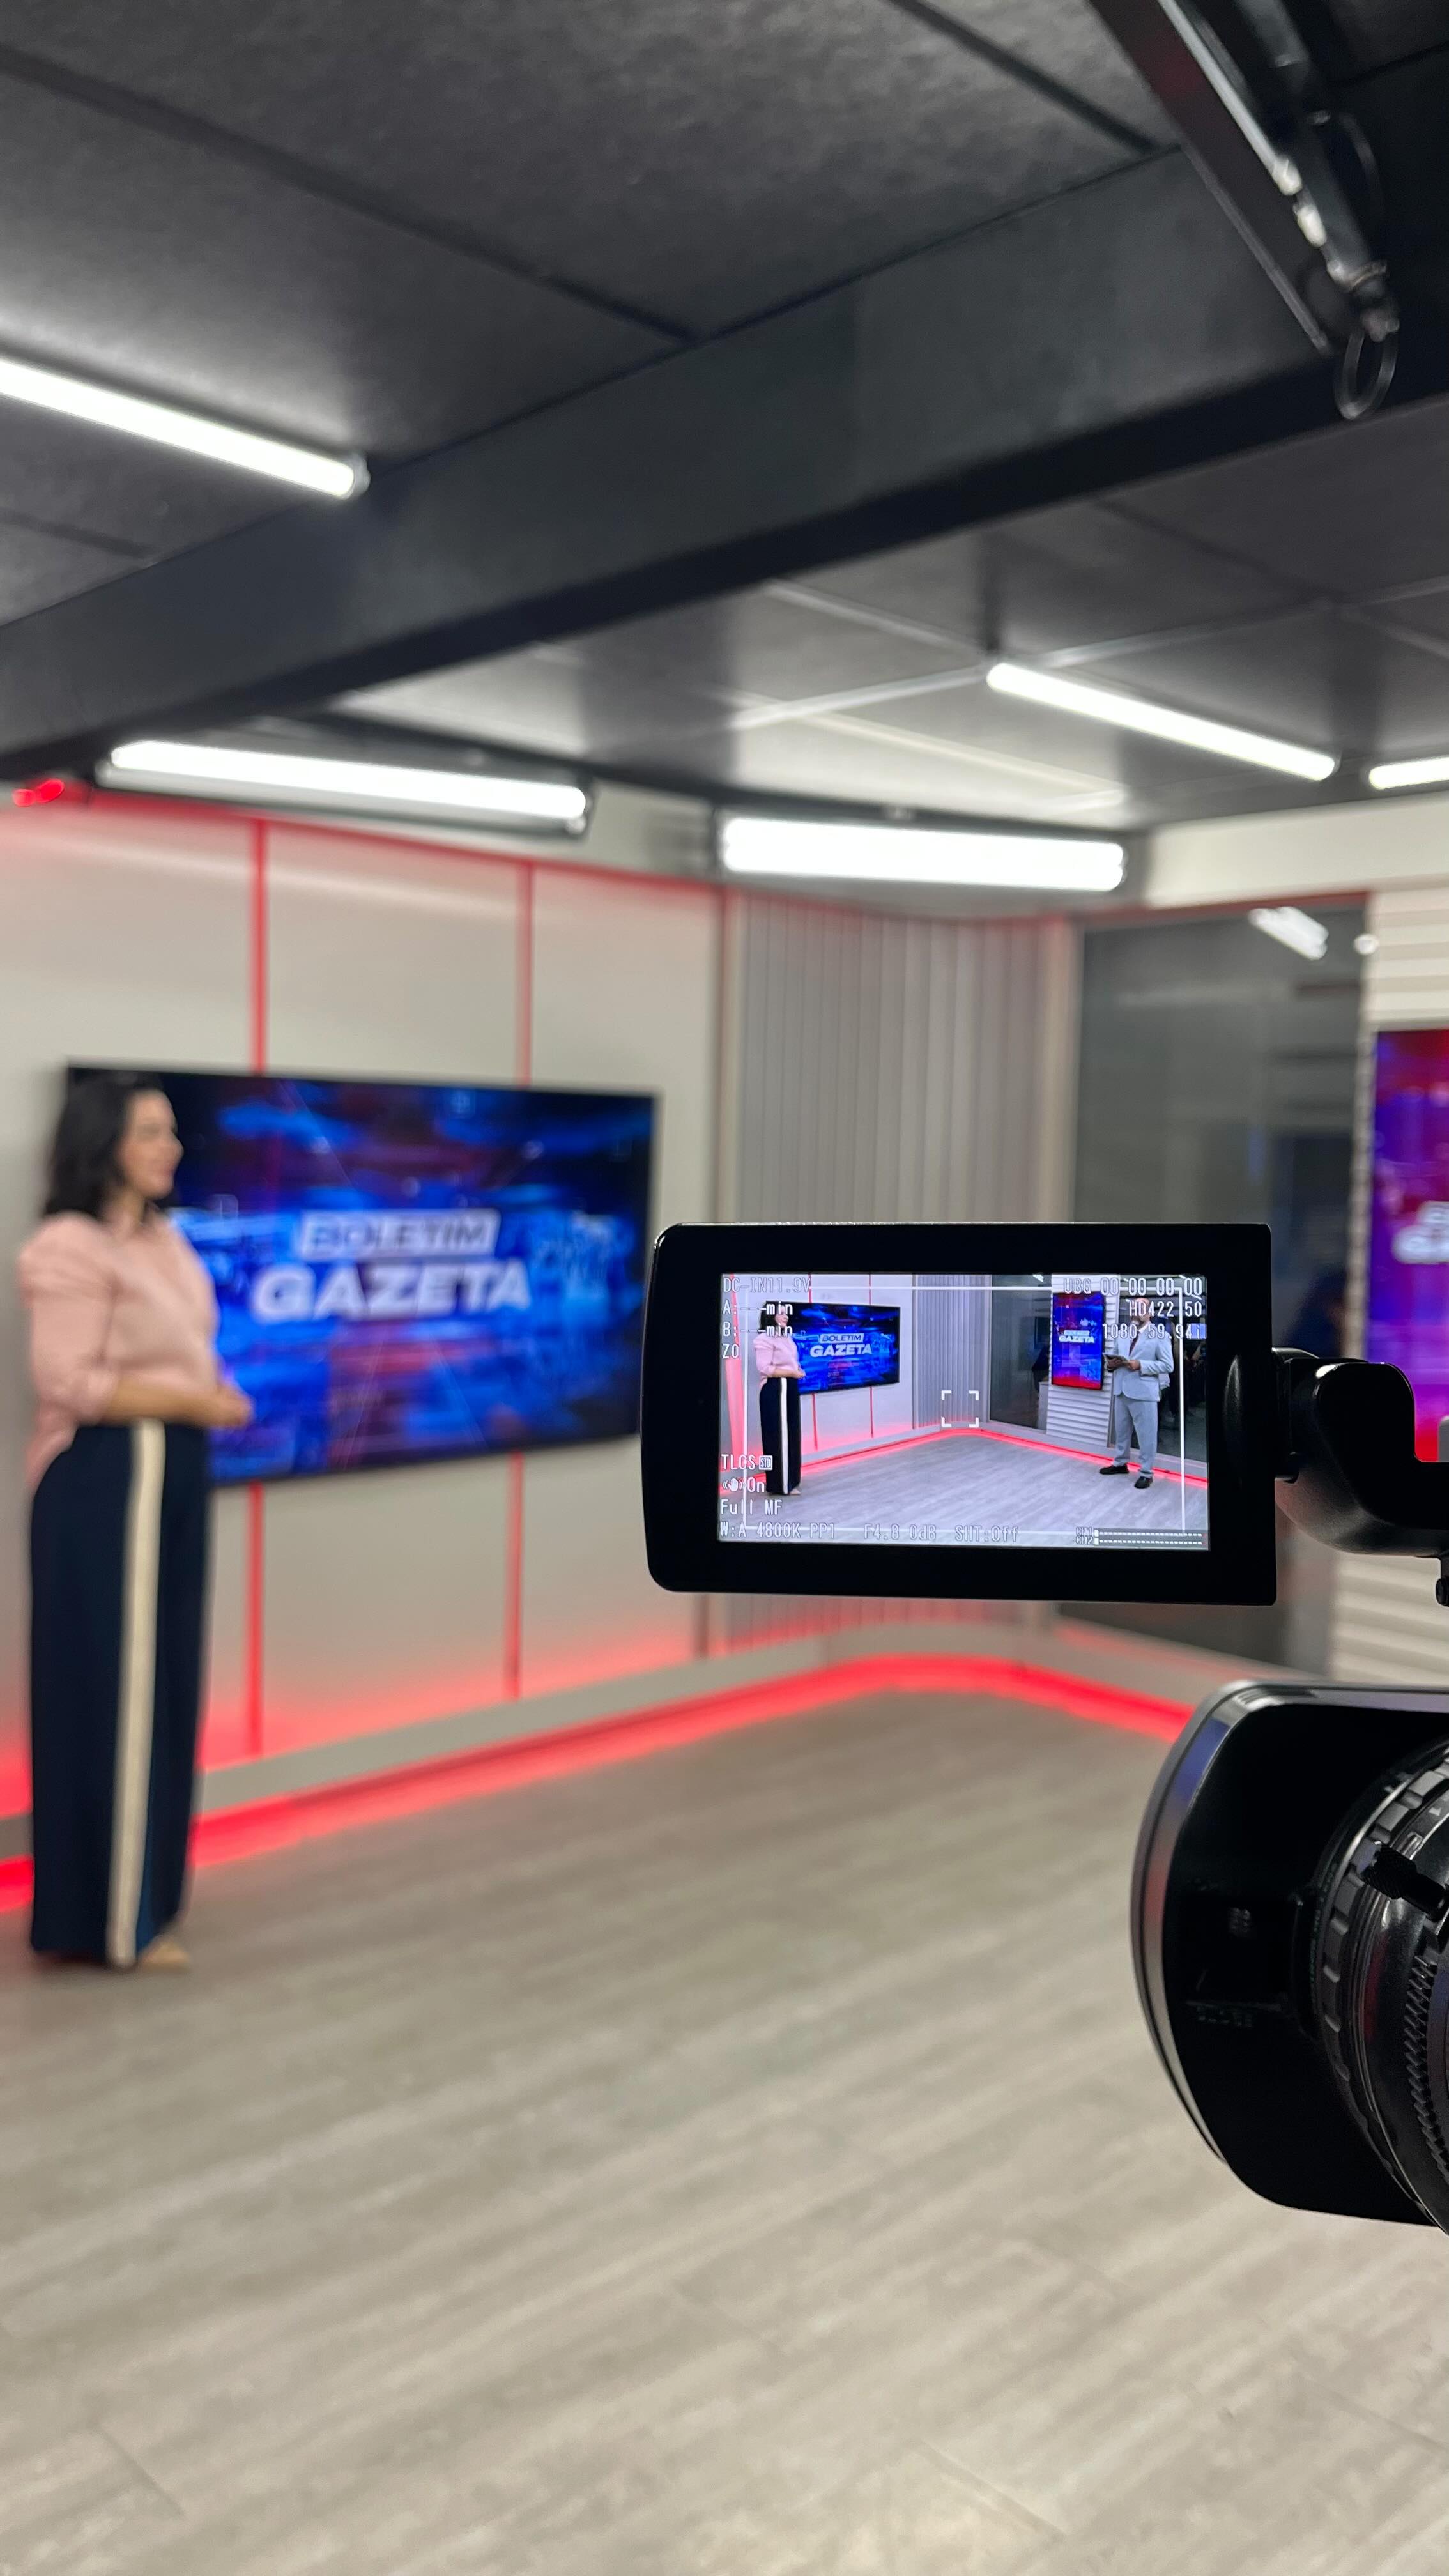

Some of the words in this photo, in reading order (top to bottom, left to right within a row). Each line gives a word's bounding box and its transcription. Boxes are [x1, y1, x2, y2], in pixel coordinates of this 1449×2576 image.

[309, 1217, 491, 1248] BOLETIM
[251, 1260, 532, 1321] GAZETA
[1064, 1277, 1092, 1294] UBG
[1128, 1301, 1174, 1317] HD422
[1184, 1301, 1202, 1317] 50
[822, 1333, 862, 1342] BOLETIM
[1103, 1323, 1137, 1339] 1080
[809, 1343, 873, 1358] GAZETA
[721, 1454, 756, 1470] TLCS
[747, 1476, 765, 1492] On
[721, 1499, 754, 1514] Full
[765, 1499, 783, 1515] MF
[720, 1522, 747, 1538] W:A
[756, 1522, 801, 1538] 4800K
[863, 1523, 900, 1540] F4.8
